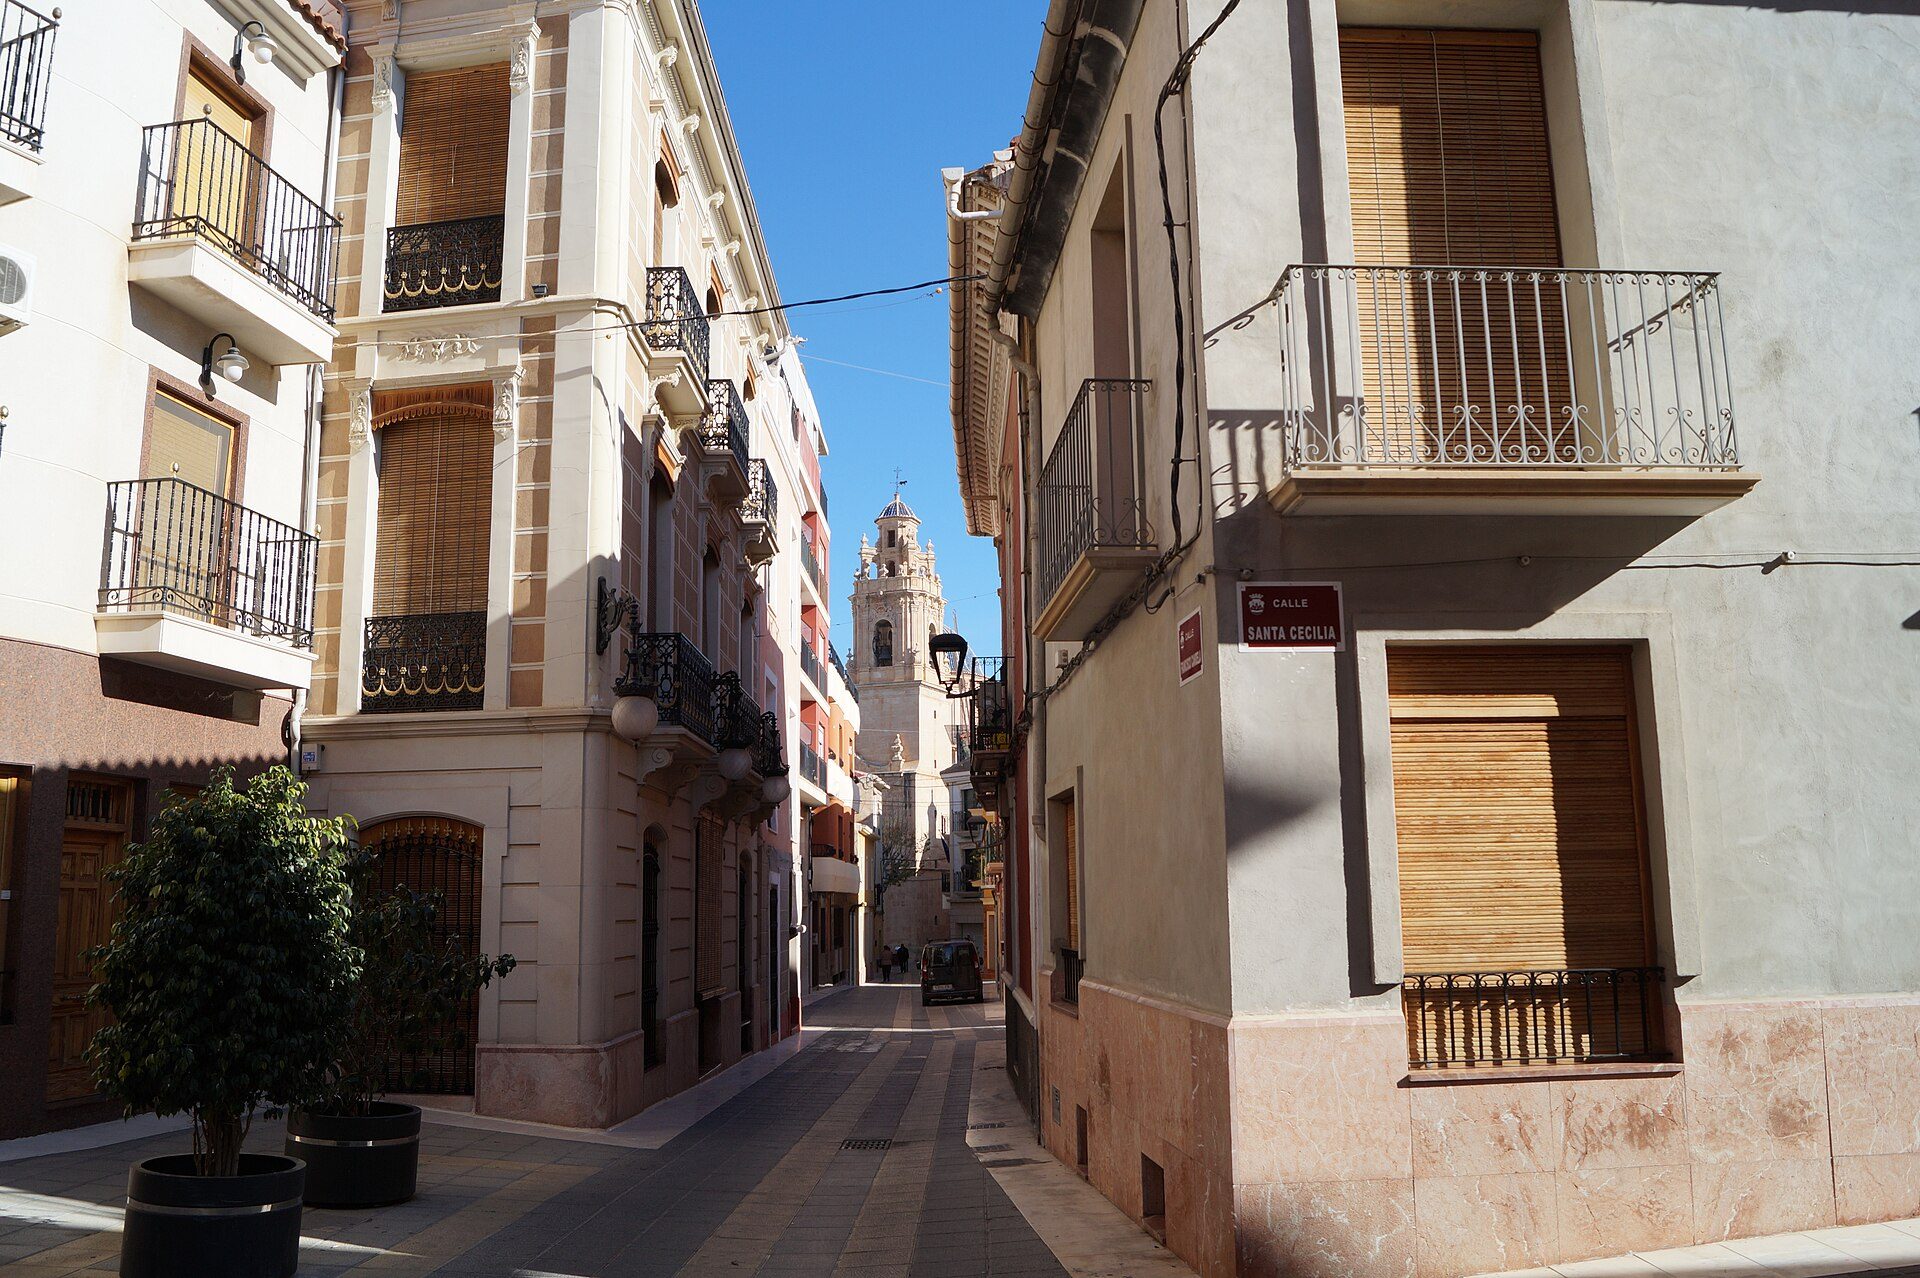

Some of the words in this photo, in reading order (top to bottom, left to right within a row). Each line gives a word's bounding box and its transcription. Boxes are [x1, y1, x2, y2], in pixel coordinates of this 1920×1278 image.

[1273, 599, 1308, 608] CALLE
[1248, 626, 1286, 640] SANTA
[1290, 625, 1336, 640] CECILIA
